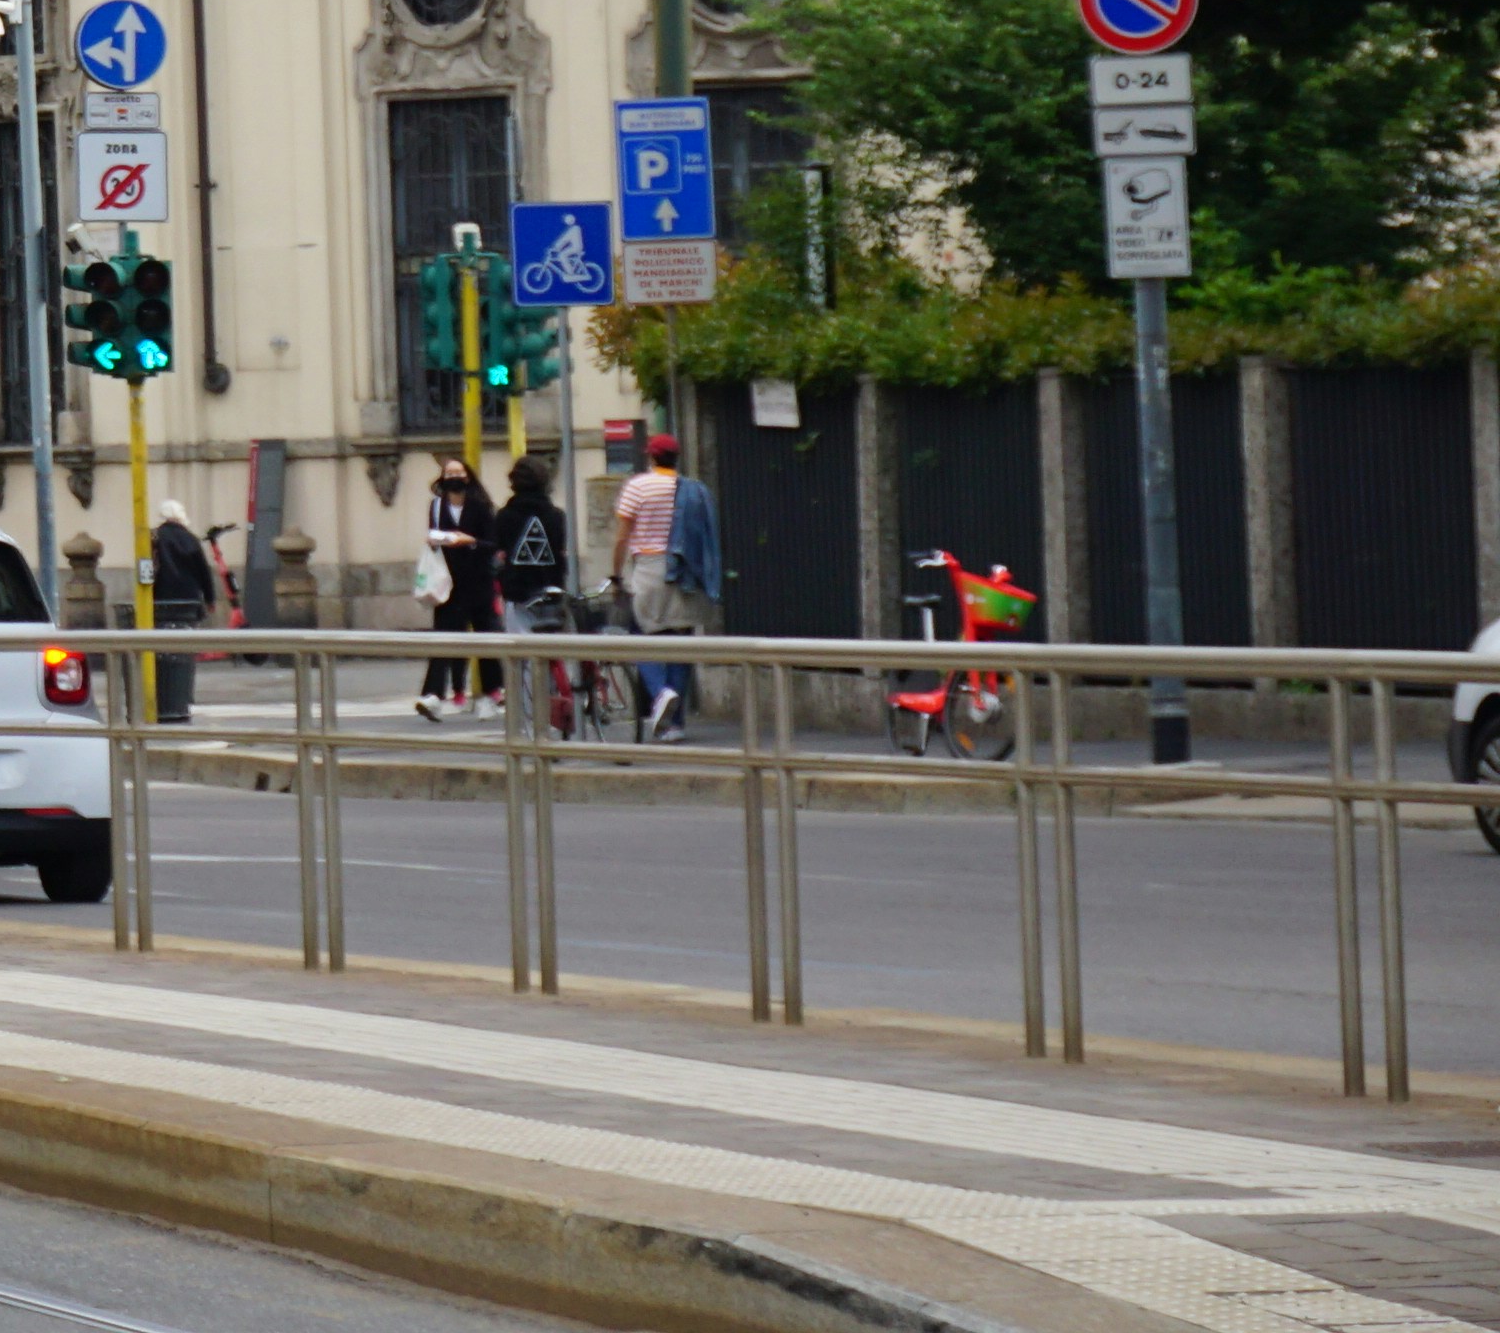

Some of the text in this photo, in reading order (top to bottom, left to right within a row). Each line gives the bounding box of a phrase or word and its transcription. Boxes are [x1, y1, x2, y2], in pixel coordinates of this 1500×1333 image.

[1115, 71, 1169, 89] 0-24
[104, 95, 142, 103] eccetto
[105, 143, 139, 154] zona
[637, 150, 669, 190] P
[1116, 226, 1142, 235] AREA
[1116, 238, 1146, 247] VIDEO
[638, 247, 700, 255] TRIBUNALE
[1116, 251, 1184, 261] SORVEGLIATA
[635, 257, 705, 266] POLICLINICO
[633, 268, 707, 277] MANGIAGALLI
[645, 289, 697, 298] VIA PACE
